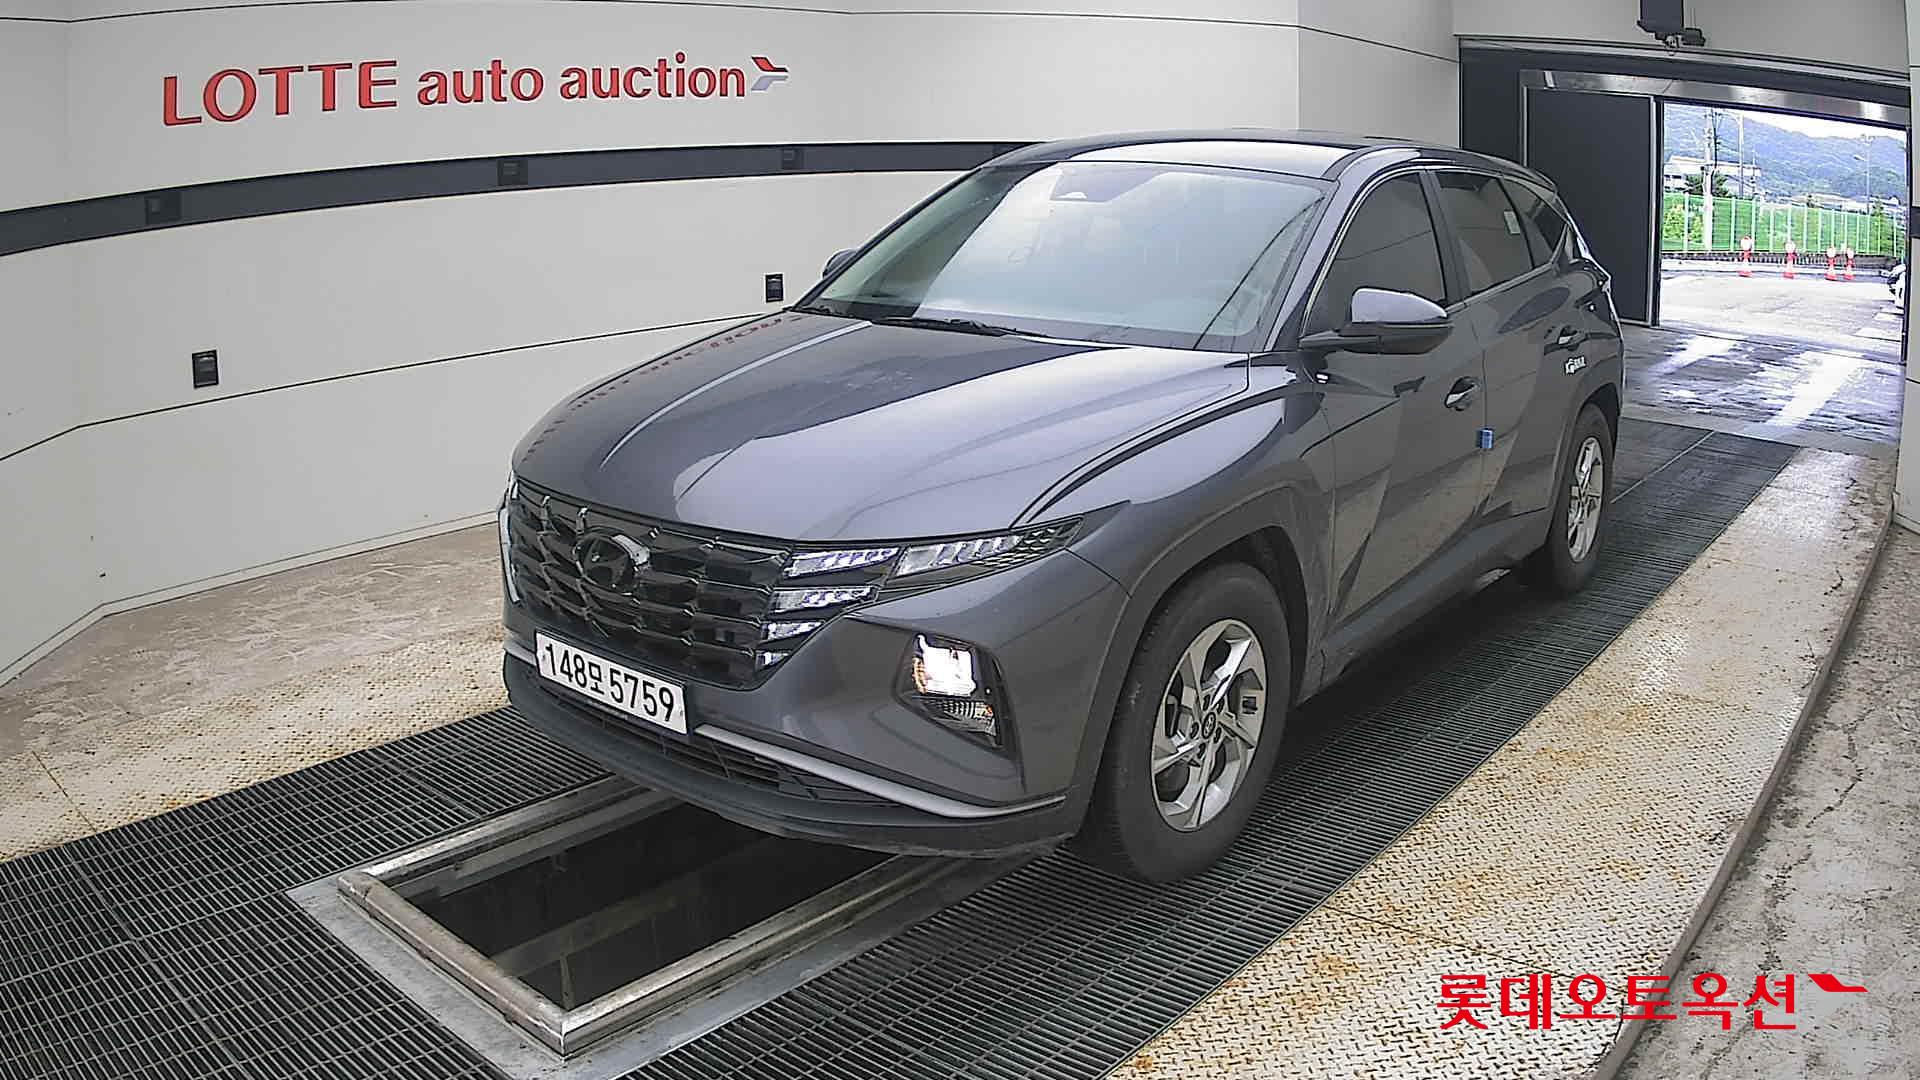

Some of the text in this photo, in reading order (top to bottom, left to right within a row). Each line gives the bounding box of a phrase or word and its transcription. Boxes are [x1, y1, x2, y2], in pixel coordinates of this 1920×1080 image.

[162, 51, 746, 126] LOTTE auto auction
